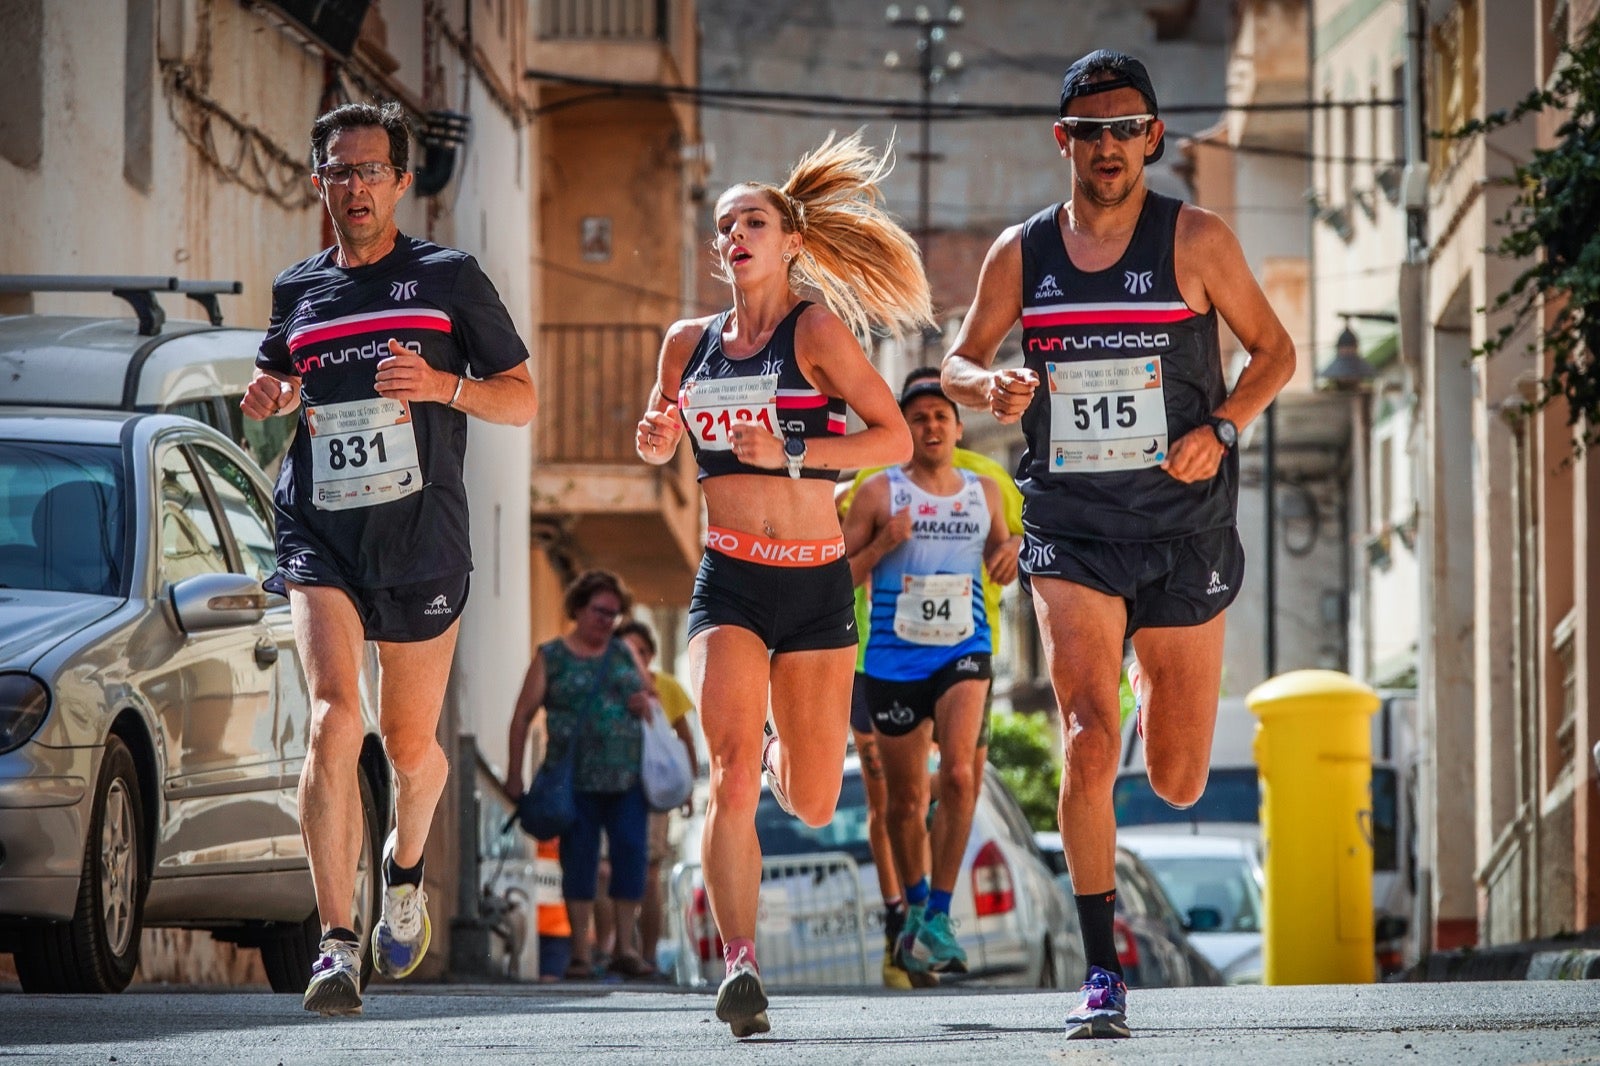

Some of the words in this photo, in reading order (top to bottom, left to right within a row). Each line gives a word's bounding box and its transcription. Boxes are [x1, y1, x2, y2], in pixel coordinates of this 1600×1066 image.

[1028, 331, 1170, 352] runrundata
[1073, 396, 1137, 430] 515
[329, 431, 387, 470] 831
[750, 541, 816, 562] NIKE
[922, 598, 952, 621] 94
